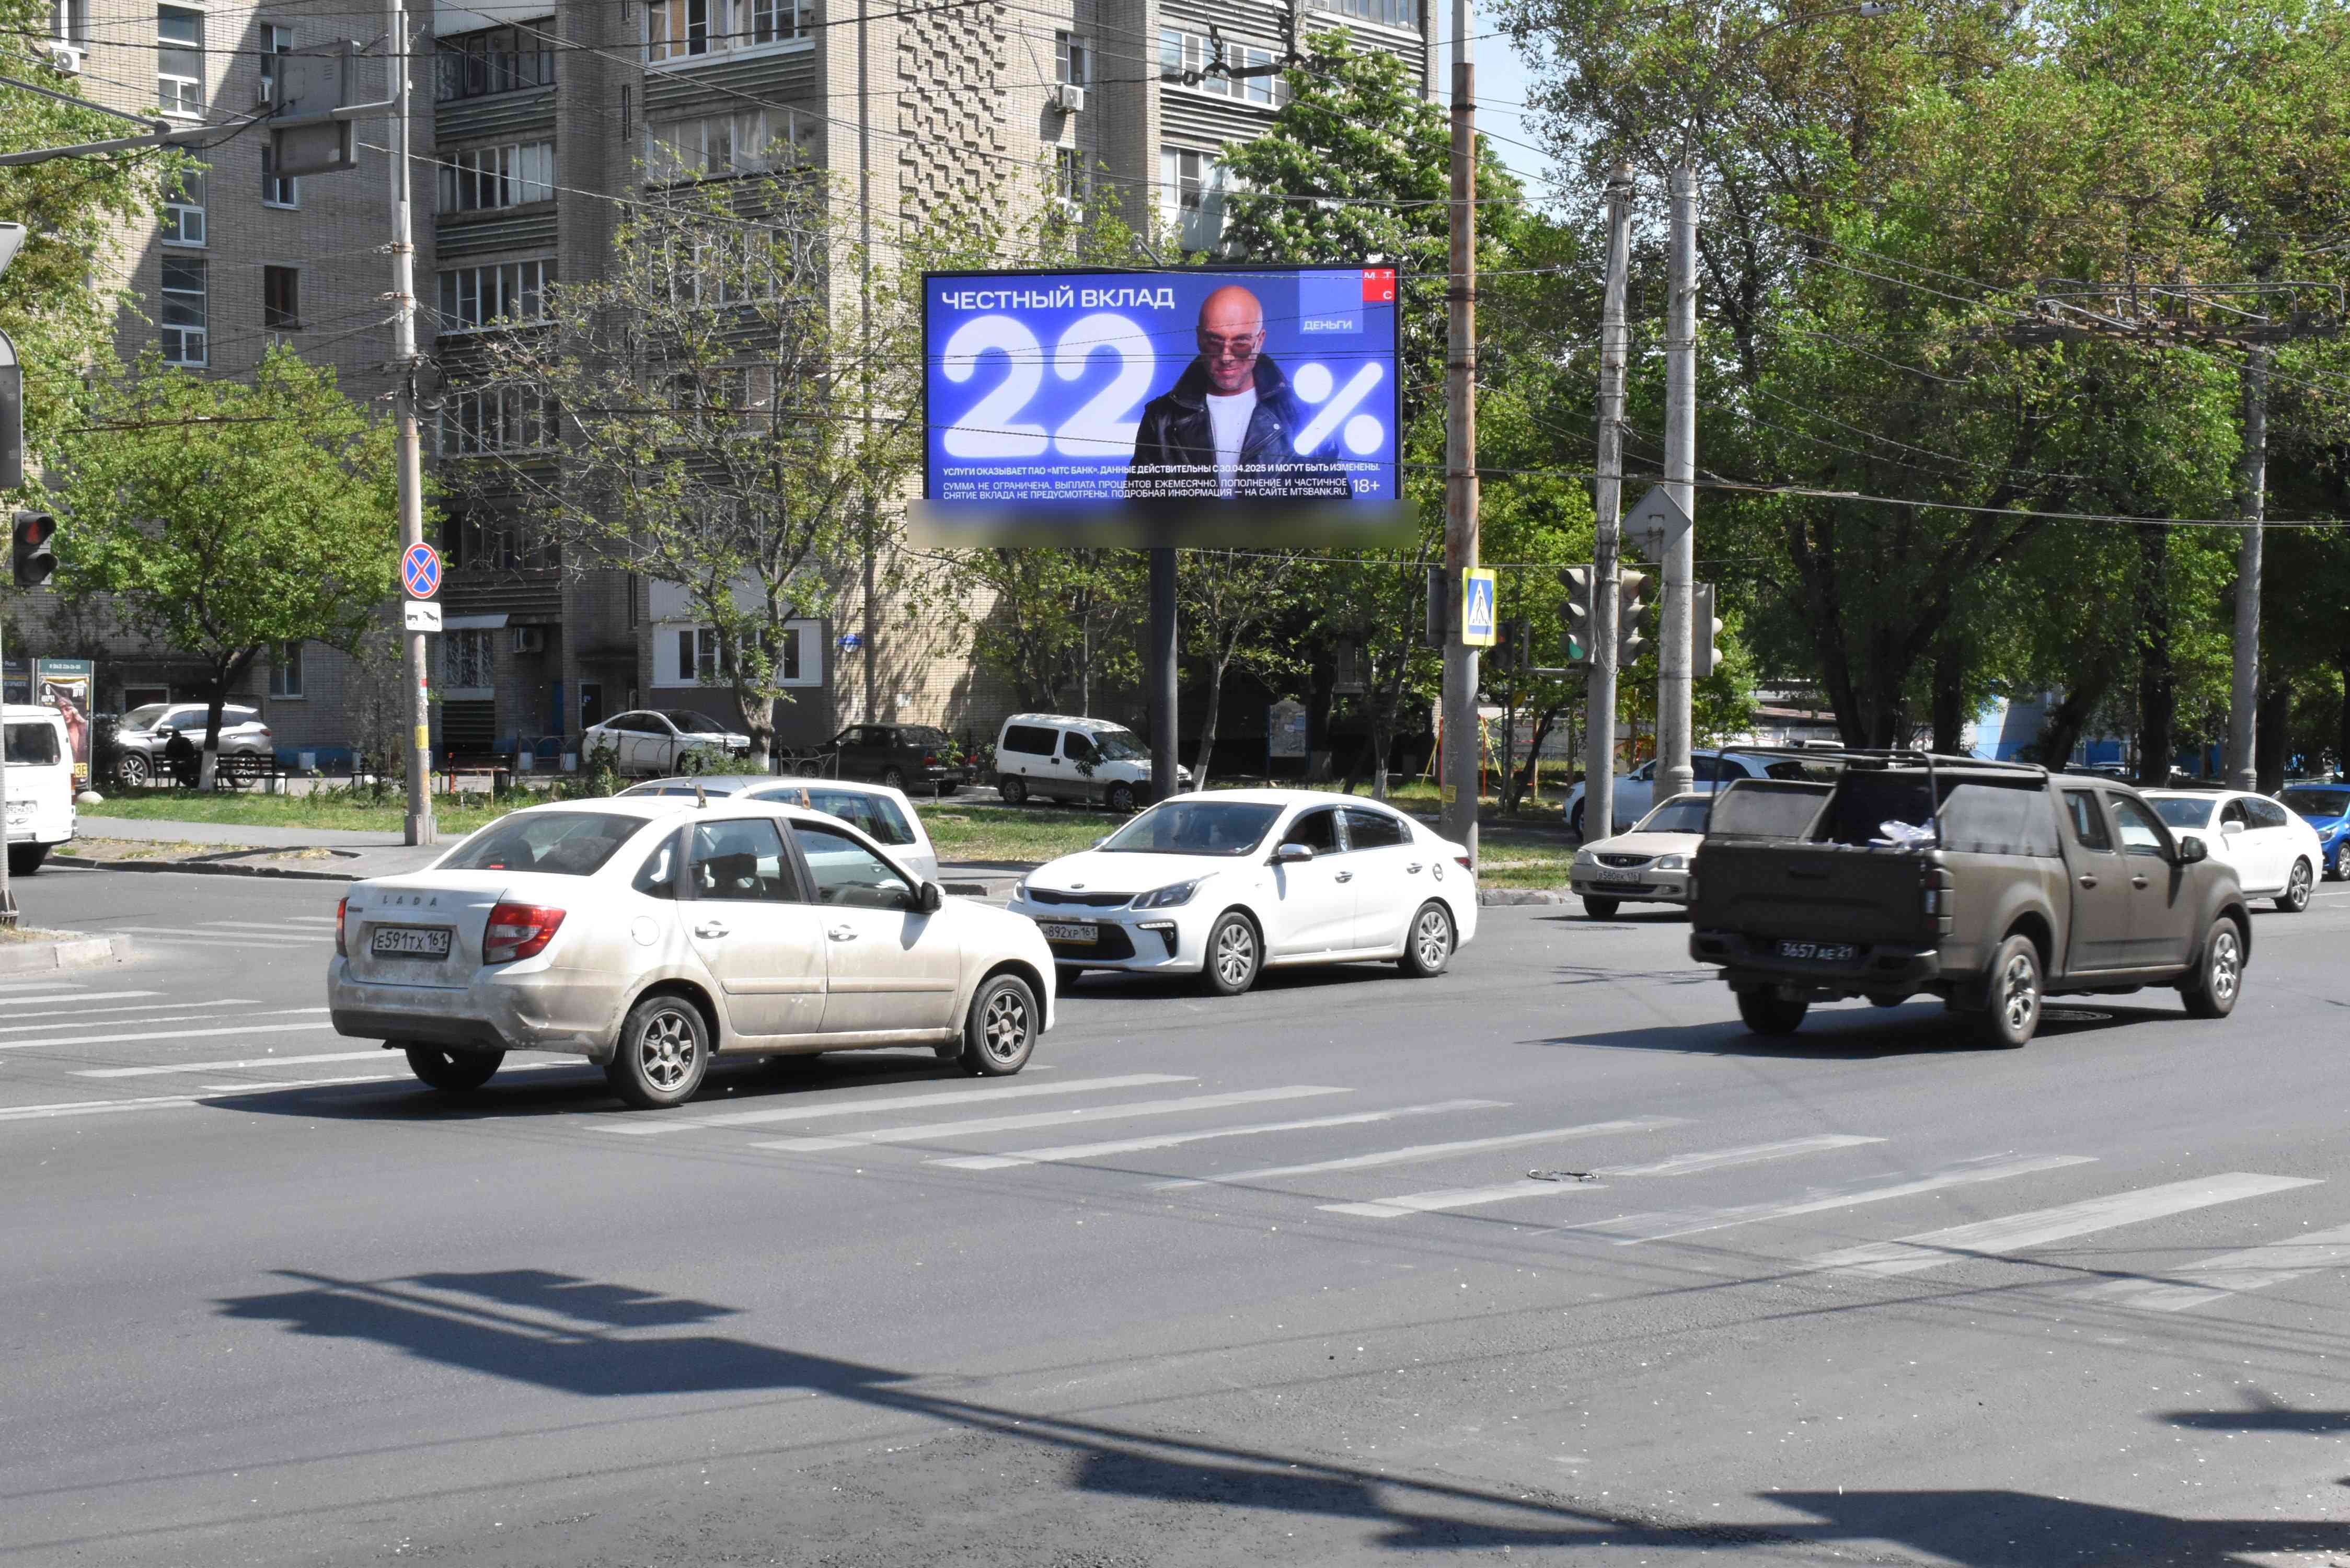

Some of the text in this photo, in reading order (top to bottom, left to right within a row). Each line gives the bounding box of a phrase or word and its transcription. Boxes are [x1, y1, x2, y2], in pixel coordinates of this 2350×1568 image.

[942, 285, 1175, 309] ЧЕСТНЫЙ ВКЛАД
[1304, 320, 1352, 331] ДЕНЬГИ
[1100, 466, 1136, 475] ДАННЫЕ
[1137, 464, 1211, 474] ДЕЙСТВИТЕЛЬНЫ
[1220, 464, 1266, 472] 30.04.2025
[993, 481, 1052, 490] ОГРАНИЧЕНА.
[1055, 481, 1096, 489] ВЫПЛАТА
[1099, 480, 1151, 489] ПРОЦЕНТОВ
[1155, 479, 1218, 488] ЕЖЕМЕСЯЧНО.
[1221, 478, 1281, 487] ПОПОЛНЕНИЕ
[1295, 478, 1347, 486] ЧАСТИЧНОЕ
[1353, 479, 1380, 492] 18+
[980, 491, 1015, 499] ВКЛАДА
[1030, 490, 1109, 499] ПРЕДУСМОТРЕНЫ.
[1111, 489, 1165, 499] ПОДРОБНАЯ
[1168, 489, 1232, 498] ИНФОРМАЦИЯ
[1259, 487, 1288, 496] САЙТЕ
[383, 895, 437, 907] LADA
